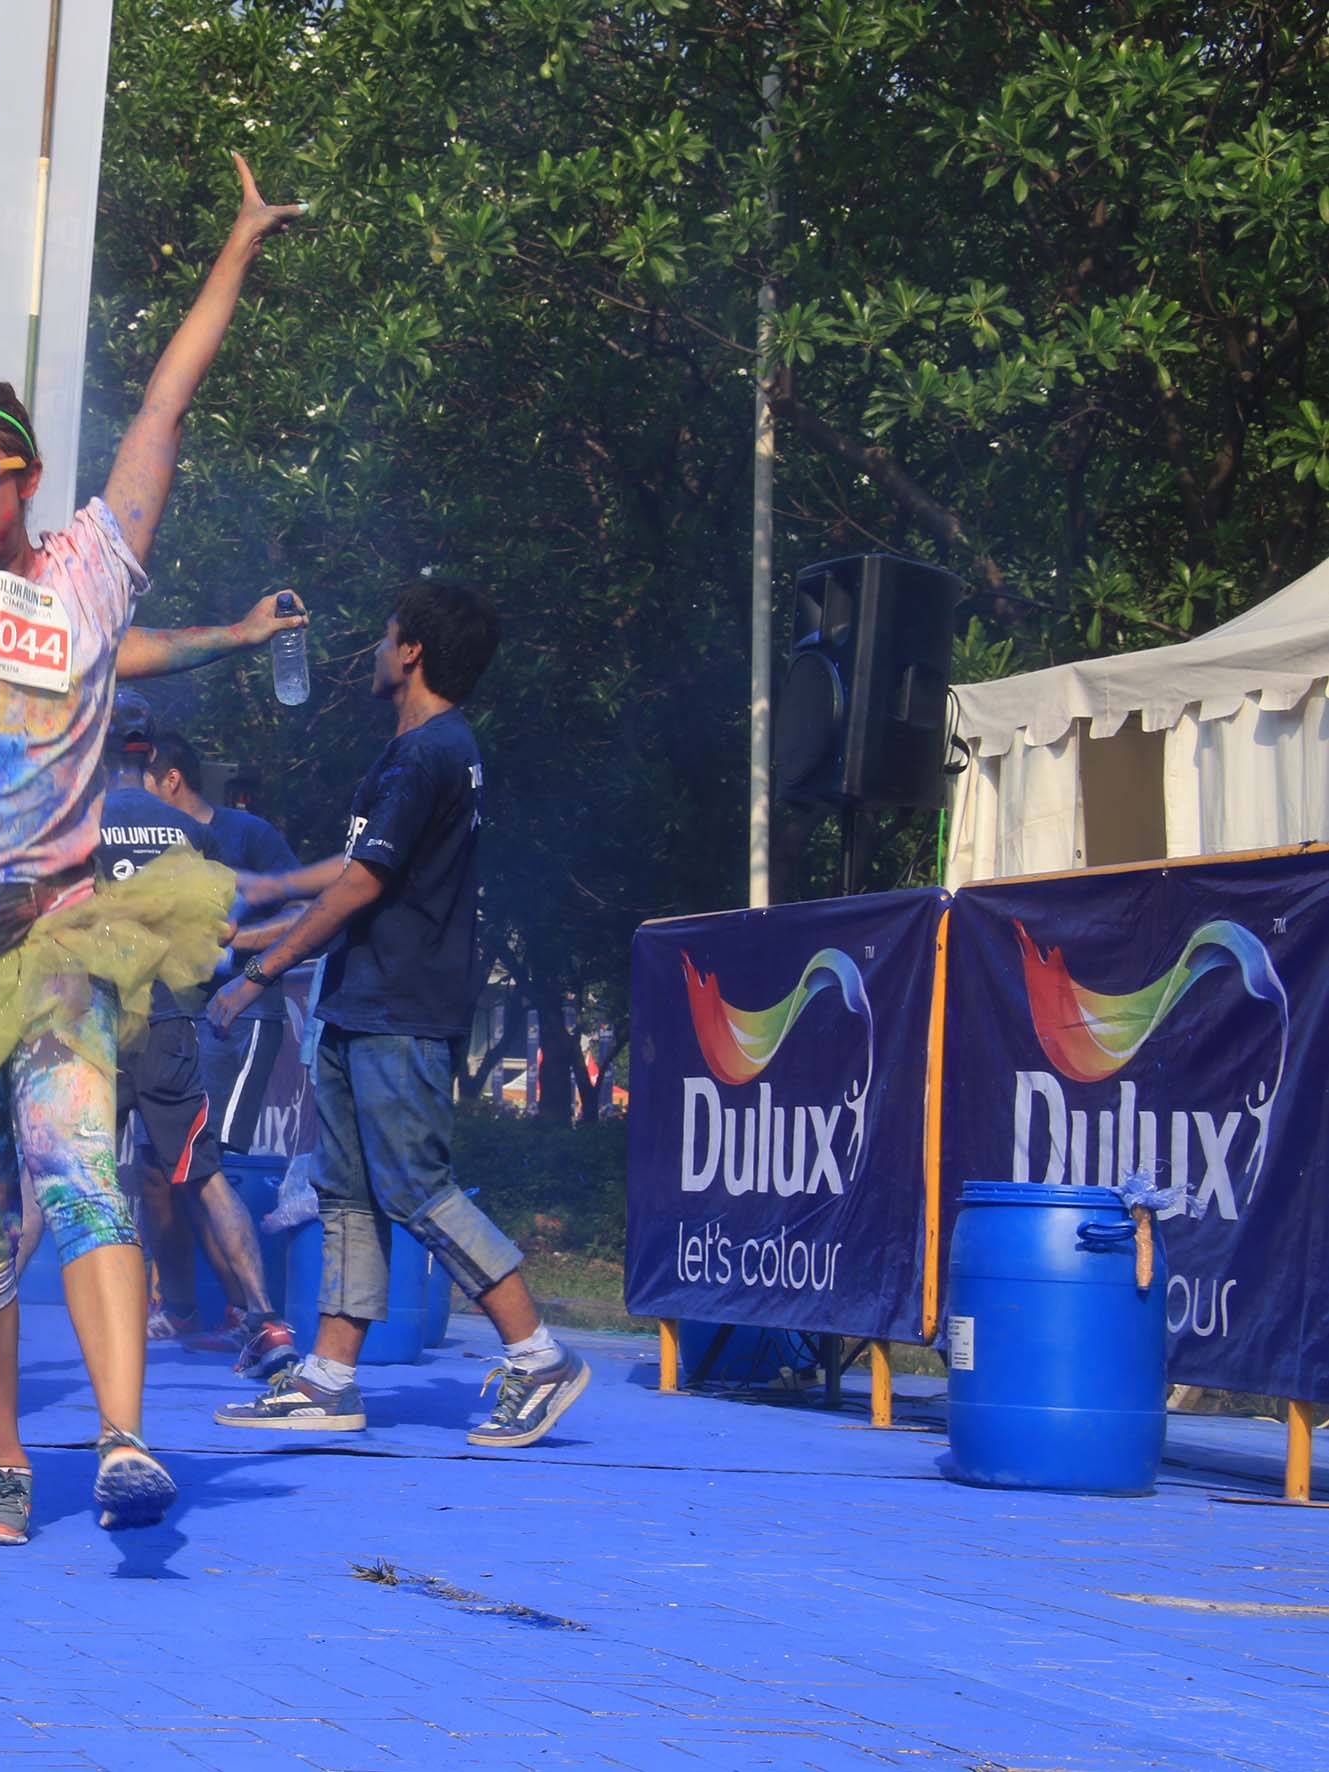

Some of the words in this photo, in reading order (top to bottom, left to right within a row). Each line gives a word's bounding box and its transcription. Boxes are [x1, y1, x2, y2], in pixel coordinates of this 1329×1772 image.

[23, 585, 39, 606] RUN
[101, 827, 187, 846] VOLUNTEER
[1273, 918, 1287, 934] TM
[865, 945, 875, 959] TM
[681, 1077, 844, 1197] Dulux
[1012, 1071, 1242, 1220] Dulux
[677, 1222, 732, 1286] let's
[741, 1225, 842, 1291] colour
